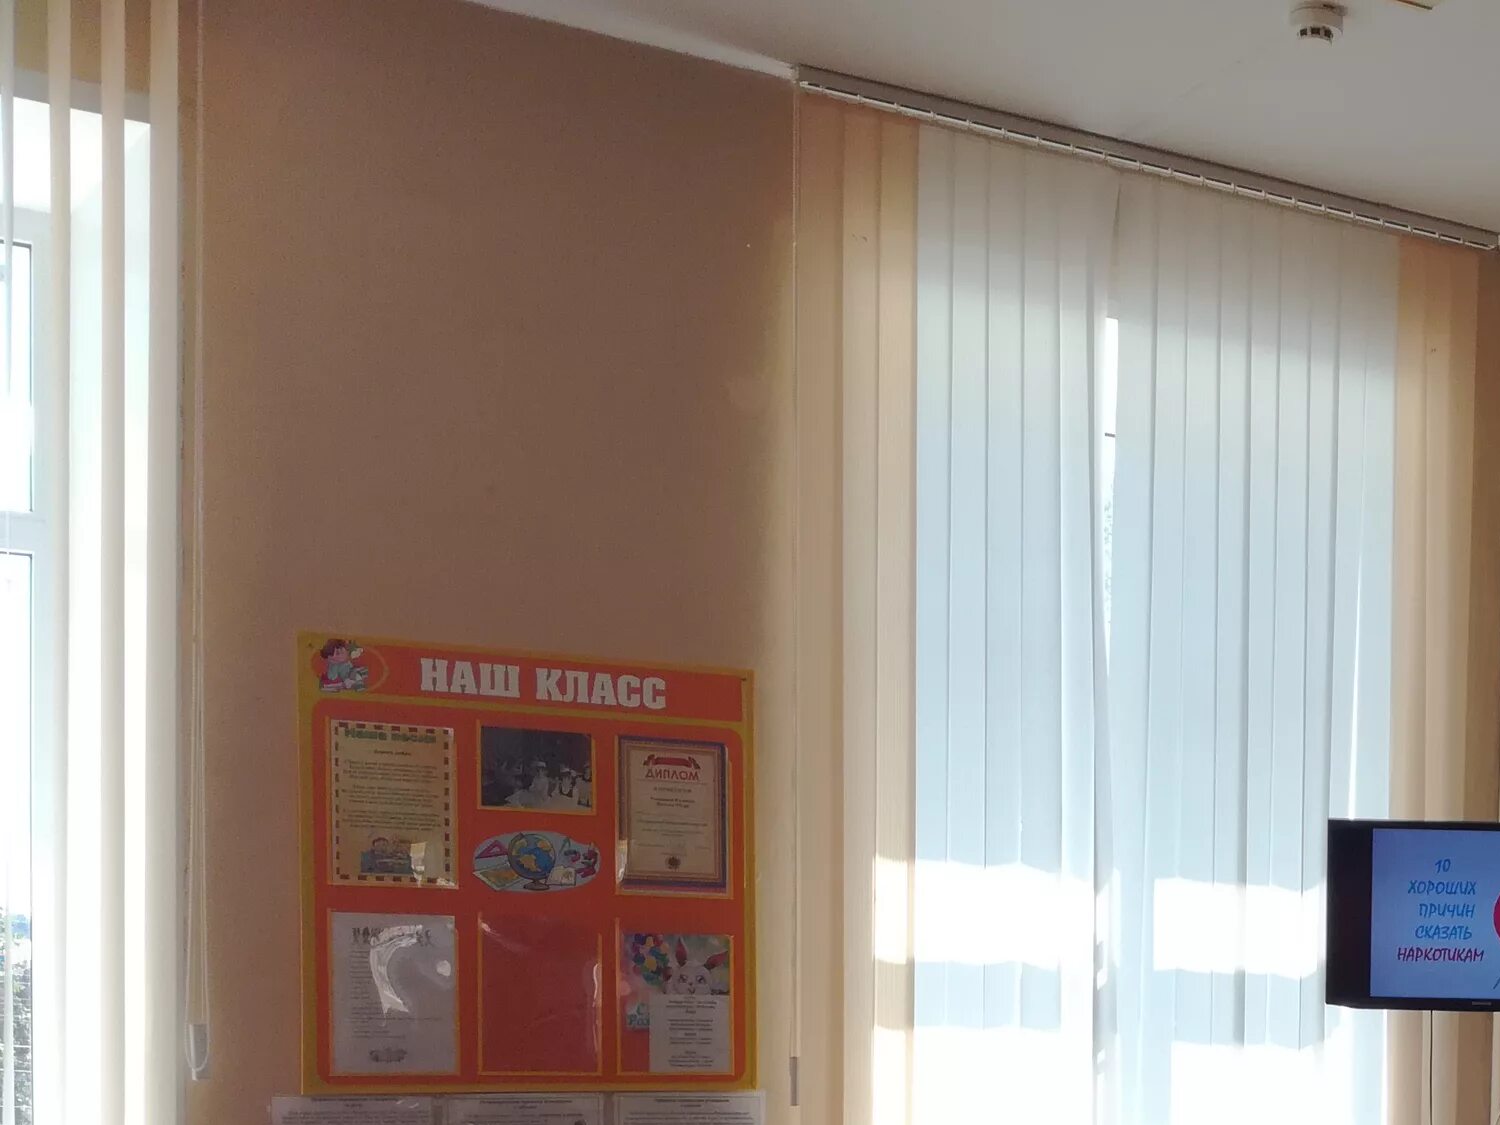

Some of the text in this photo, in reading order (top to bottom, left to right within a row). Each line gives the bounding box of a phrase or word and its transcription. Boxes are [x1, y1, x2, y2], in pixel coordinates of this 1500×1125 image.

[420, 657, 666, 709] НАШ КЛАСС
[645, 769, 699, 781] ДИПЛОМ
[1435, 859, 1451, 874] 10
[1407, 879, 1477, 896] ХОРОШИХ
[1419, 903, 1475, 918] ПРИЧИН
[1415, 925, 1473, 940] СКАЗАТЬ
[1397, 947, 1484, 963] НАРКОТИКАМ
